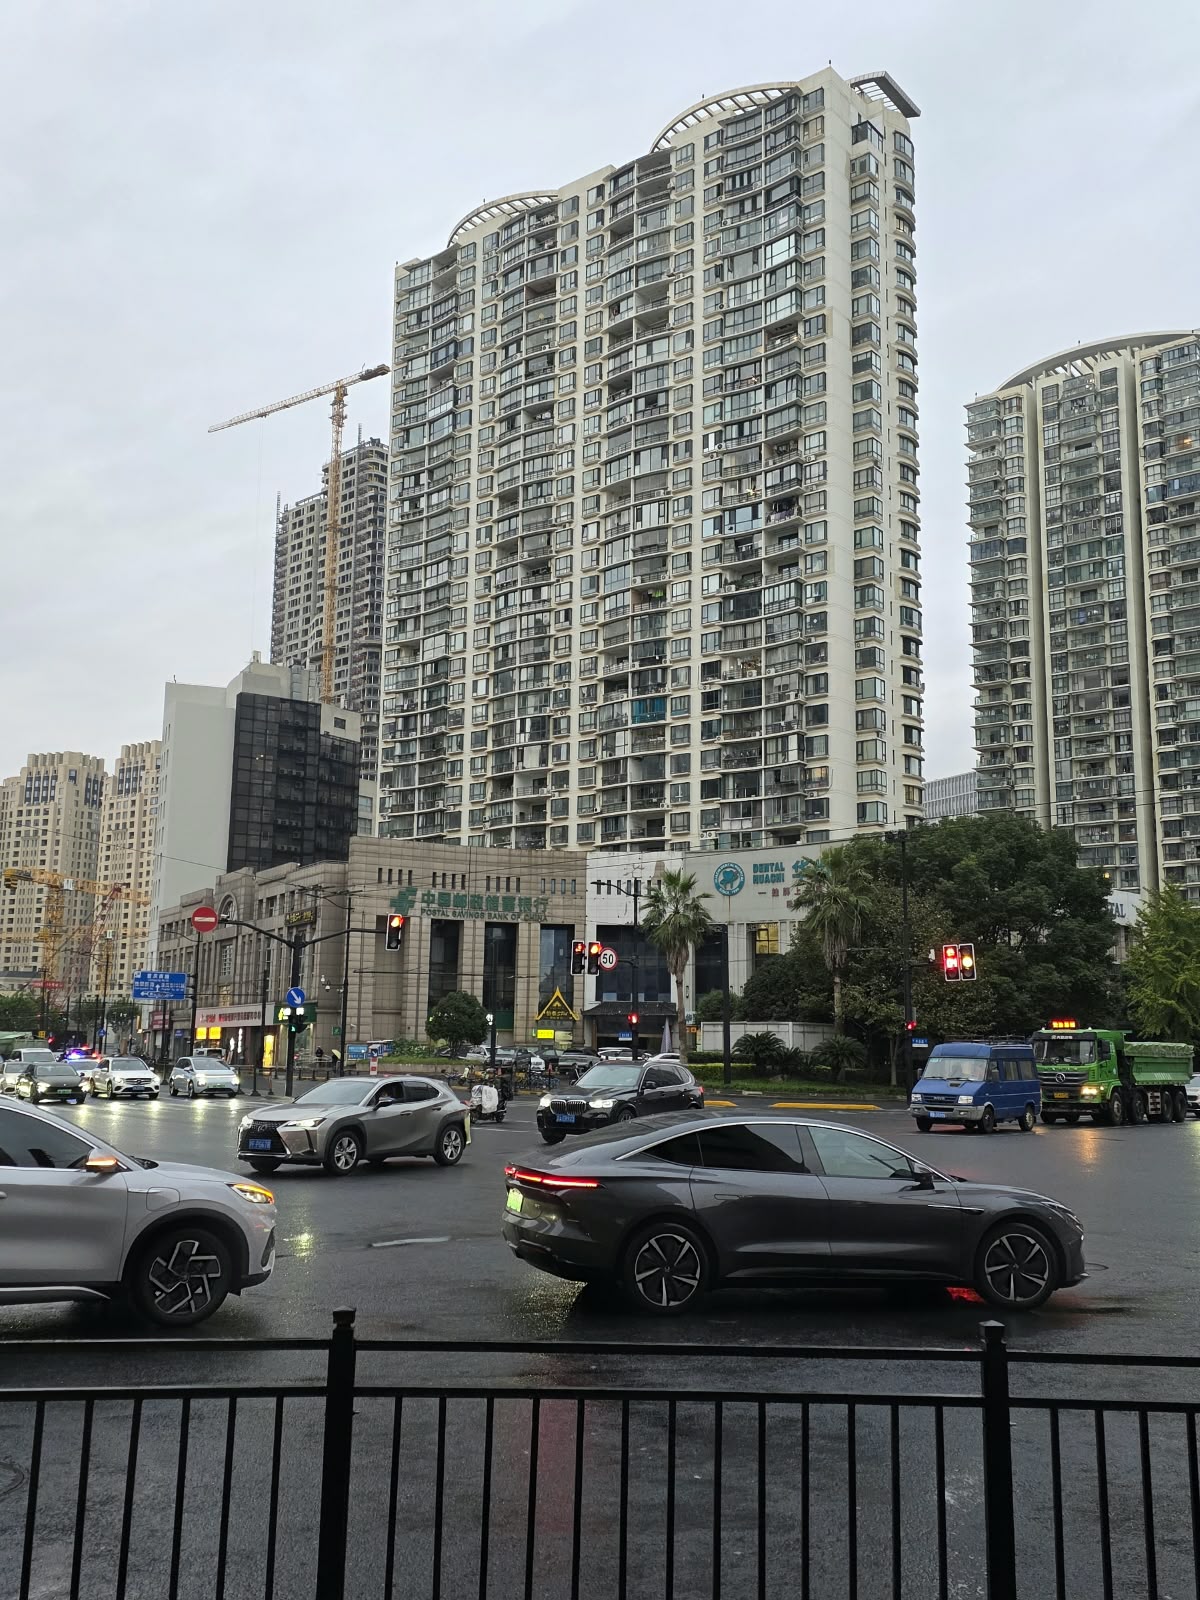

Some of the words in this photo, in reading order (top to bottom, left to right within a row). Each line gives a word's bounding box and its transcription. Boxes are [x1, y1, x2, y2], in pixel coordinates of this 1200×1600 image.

[752, 862, 785, 873] DENTAL
[752, 873, 785, 884] HUACHI
[421, 889, 549, 913] 中国邮政储蓄银行
[421, 908, 450, 918] POSTAL
[452, 909, 485, 919] SAVINGS
[488, 912, 509, 921] BANK
[510, 913, 521, 921] OF
[523, 912, 548, 922] CHINA
[602, 953, 614, 965] 50
